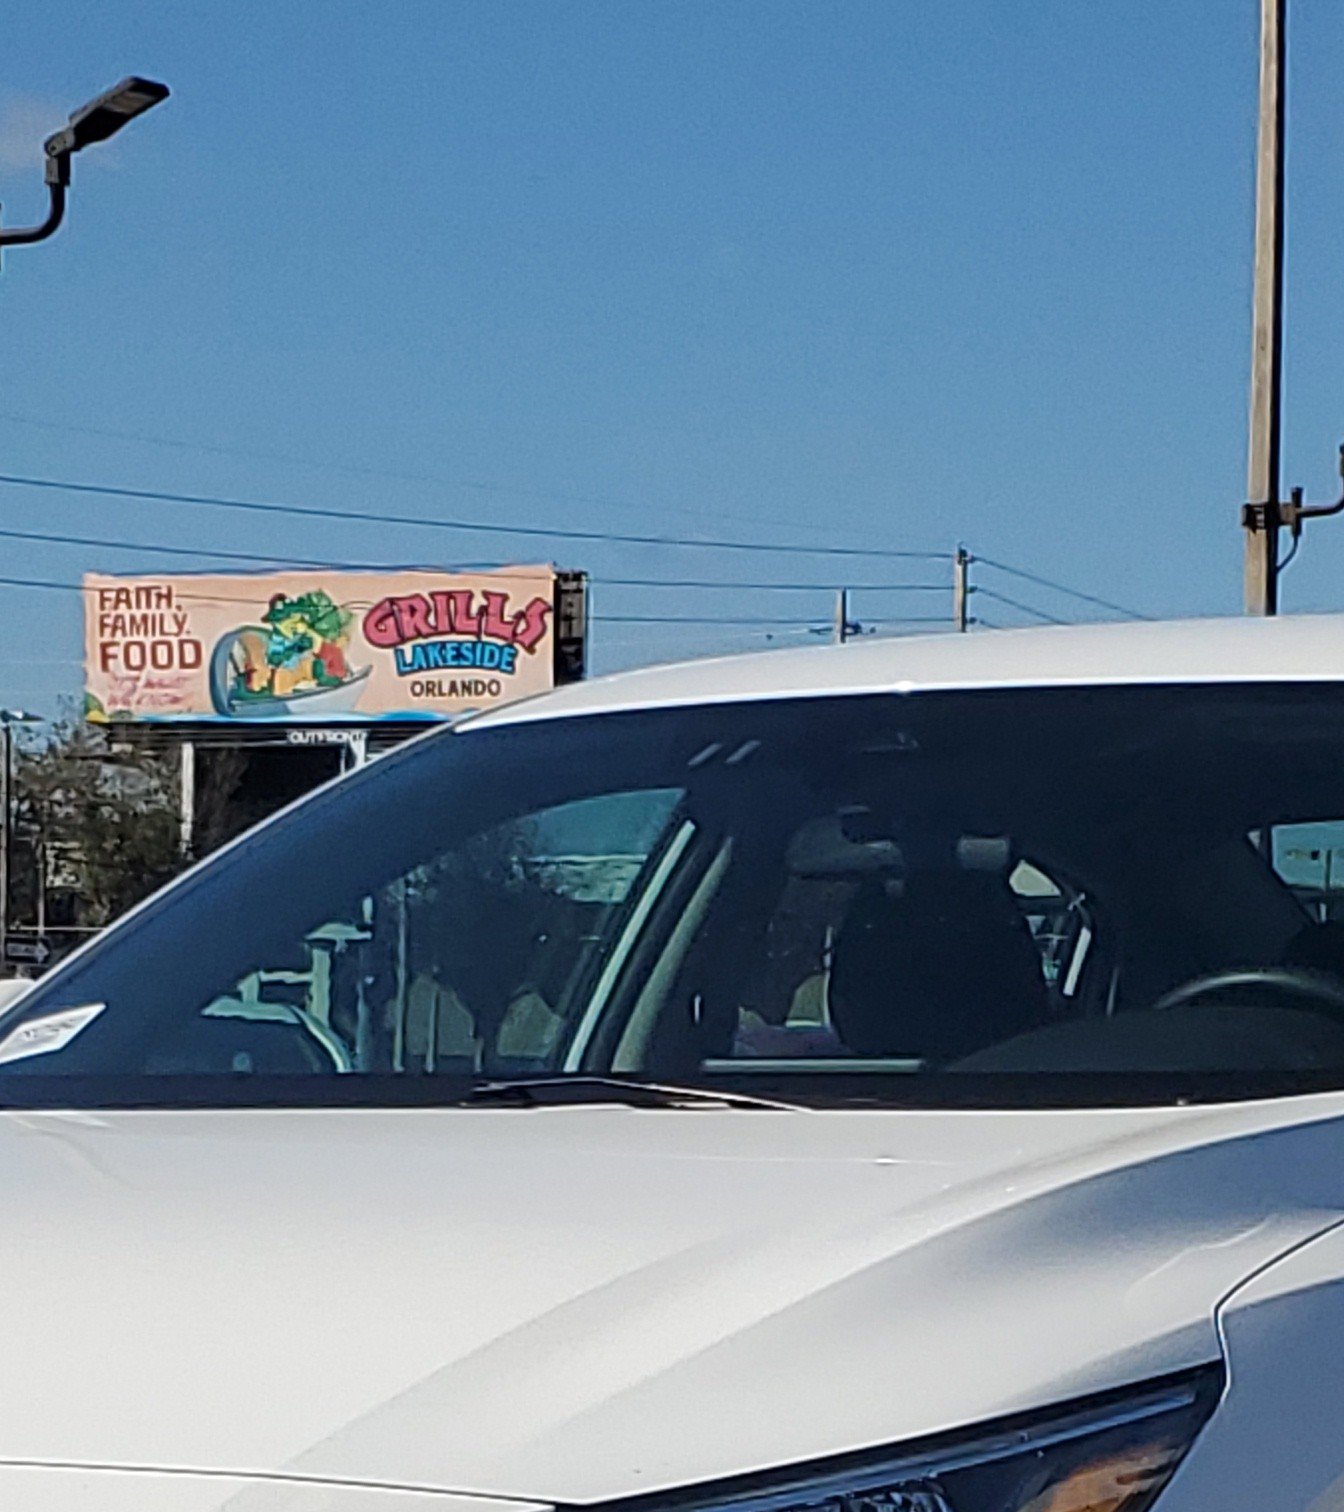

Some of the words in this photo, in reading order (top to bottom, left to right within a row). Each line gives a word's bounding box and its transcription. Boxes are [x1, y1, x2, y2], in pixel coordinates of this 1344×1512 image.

[363, 590, 552, 654] GRILLS
[99, 638, 202, 673] FOOD
[394, 640, 518, 676] LAKESIDE
[410, 679, 501, 698] ORLANDO
